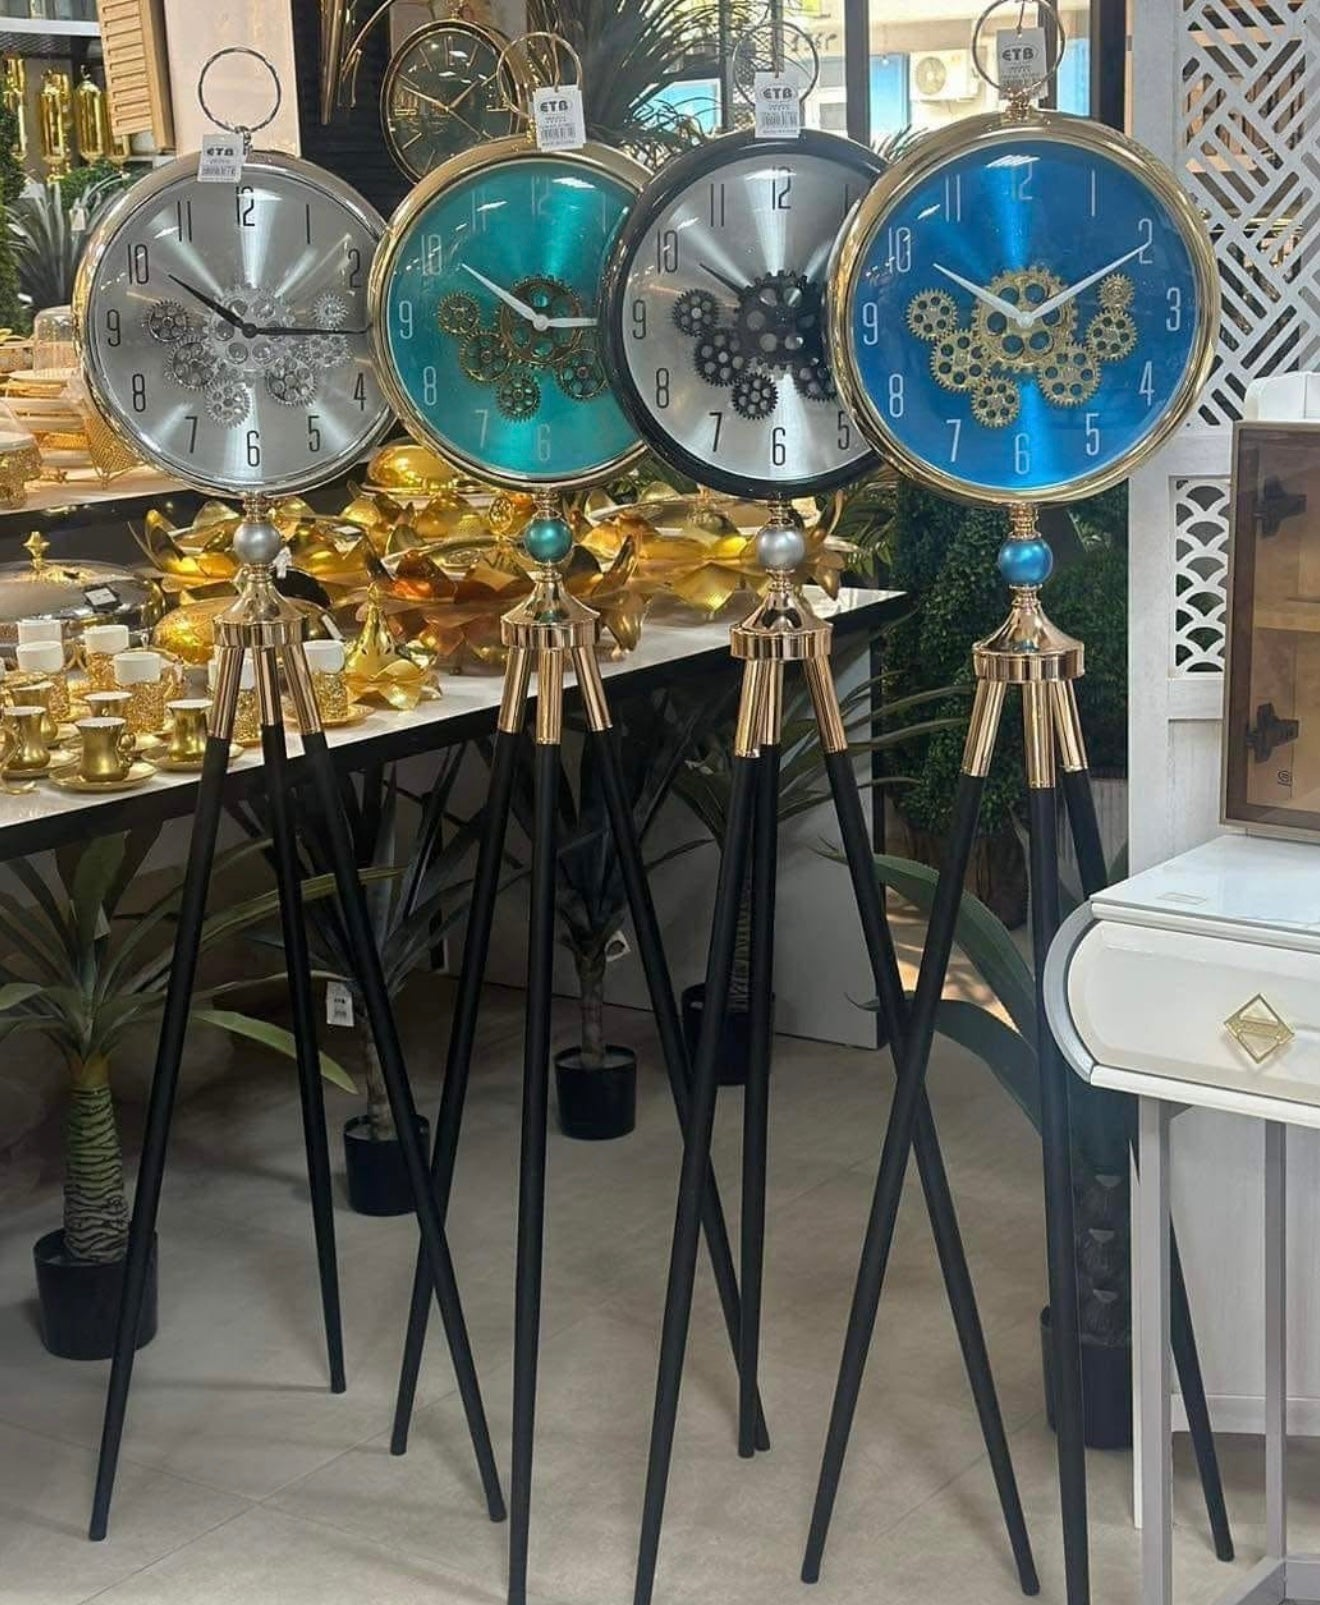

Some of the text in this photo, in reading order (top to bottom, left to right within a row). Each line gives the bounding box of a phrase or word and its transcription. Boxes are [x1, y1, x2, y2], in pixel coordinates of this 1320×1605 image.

[1002, 47, 1033, 61] ETB
[540, 101, 568, 111] ETB
[763, 88, 792, 99] ETB
[207, 148, 234, 156] ETB
[236, 186, 255, 227] 12
[710, 183, 726, 227] 11
[771, 166, 791, 210] 12
[945, 174, 961, 222] 11
[177, 201, 193, 243] 11
[305, 204, 311, 244] 1
[1139, 219, 1153, 265] 2
[127, 244, 148, 284] 10
[348, 249, 361, 288] 2
[421, 234, 442, 275] 10
[657, 230, 678, 274] 10
[888, 227, 911, 272] 10
[107, 309, 121, 347] 9
[399, 301, 413, 340] 9
[632, 299, 646, 339] 9
[863, 302, 878, 345] 9
[1167, 288, 1181, 332] 3
[132, 374, 146, 412] 8
[353, 373, 366, 411] 4
[423, 366, 437, 405] 8
[656, 368, 669, 408] 8
[889, 374, 903, 418] 8
[1139, 361, 1155, 406] 4
[185, 416, 198, 454] 7
[309, 416, 320, 452] 5
[475, 409, 488, 448] 7
[537, 424, 551, 462] 6
[710, 412, 722, 452] 7
[772, 427, 786, 466] 6
[837, 411, 850, 450] 5
[946, 419, 961, 462] 7
[1085, 413, 1100, 456] 5
[246, 431, 260, 467] 6
[1015, 433, 1029, 475] 6
